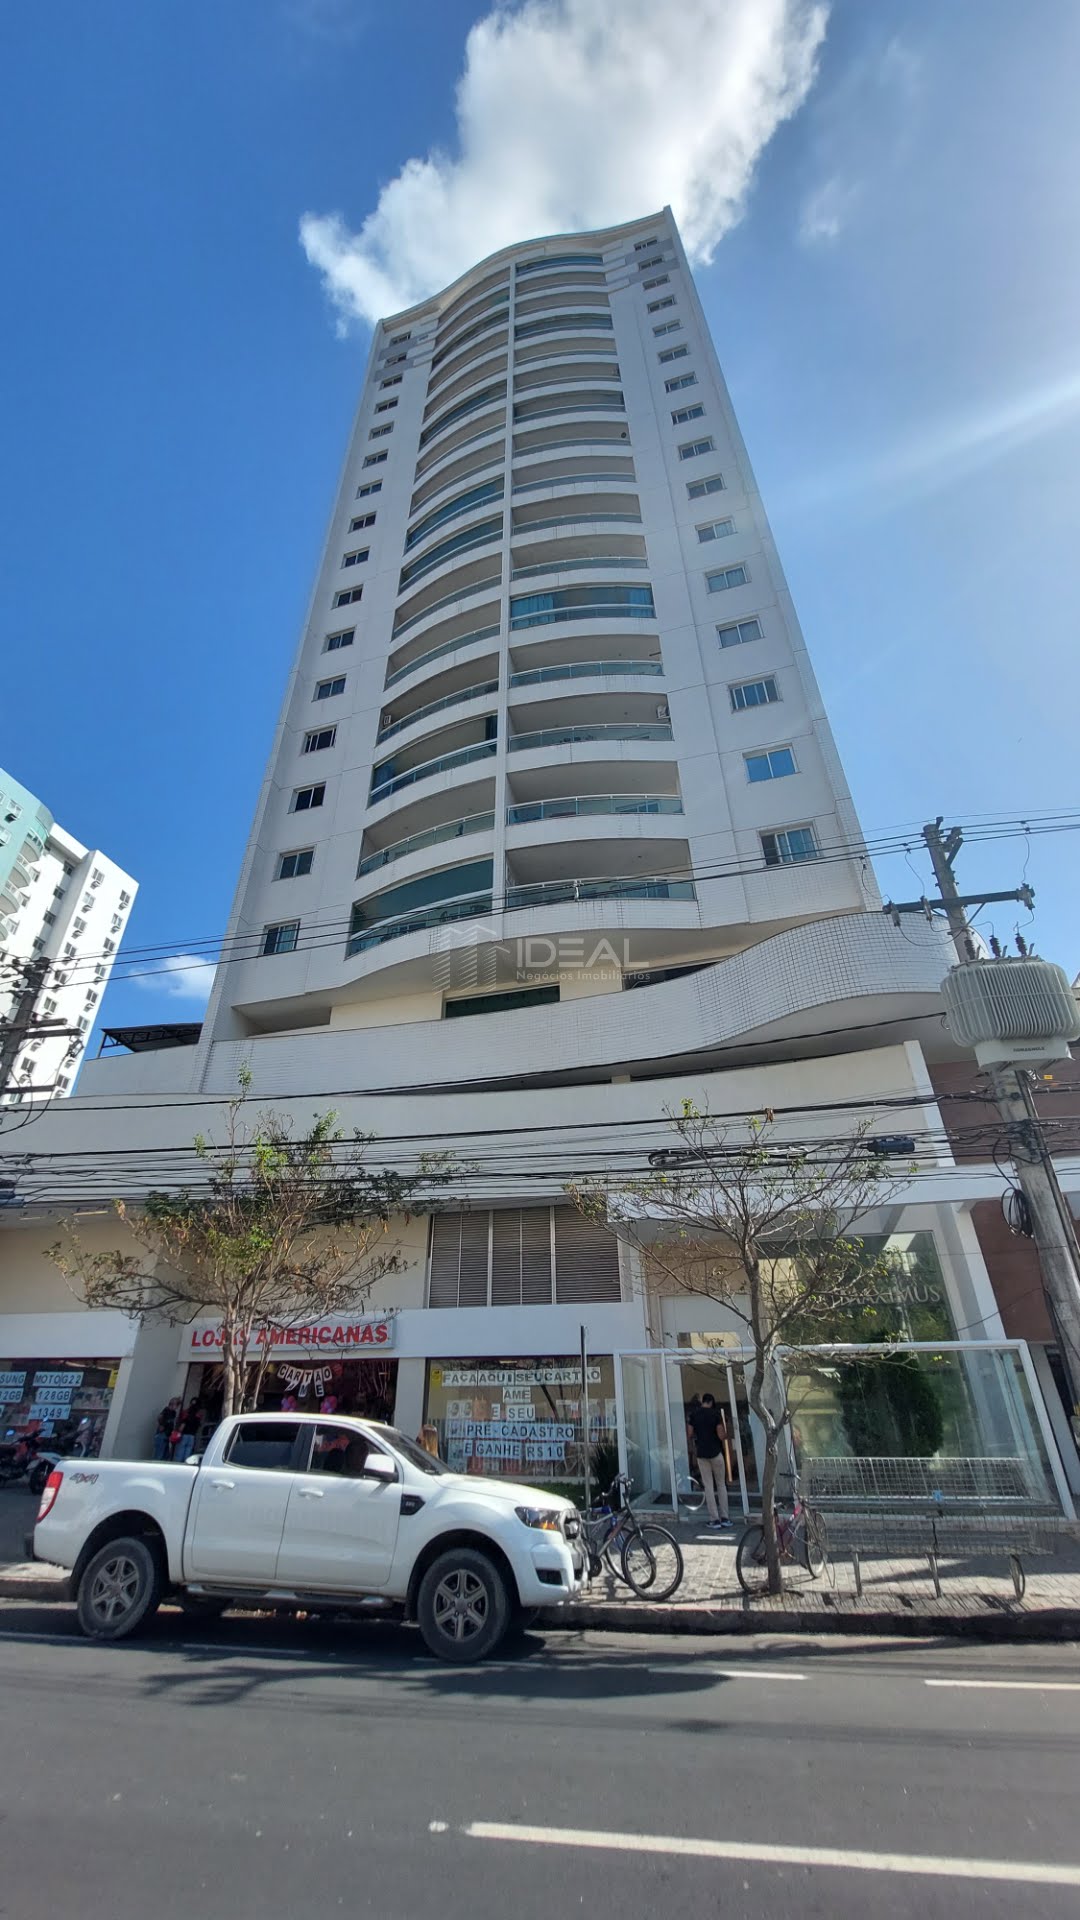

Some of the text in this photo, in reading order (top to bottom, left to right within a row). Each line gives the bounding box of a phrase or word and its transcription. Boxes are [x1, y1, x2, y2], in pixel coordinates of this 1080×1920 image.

[255, 1324, 388, 1345] AMERICANAS
[515, 1372, 543, 1382] SEU
[544, 1370, 599, 1383] CARTO
[38, 1390, 70, 1401] 128GB
[503, 1388, 531, 1400] AME
[38, 1407, 63, 1418] 1349
[508, 1408, 535, 1420] SEU
[465, 1442, 472, 1454] E
[476, 1442, 521, 1456] GANHE
